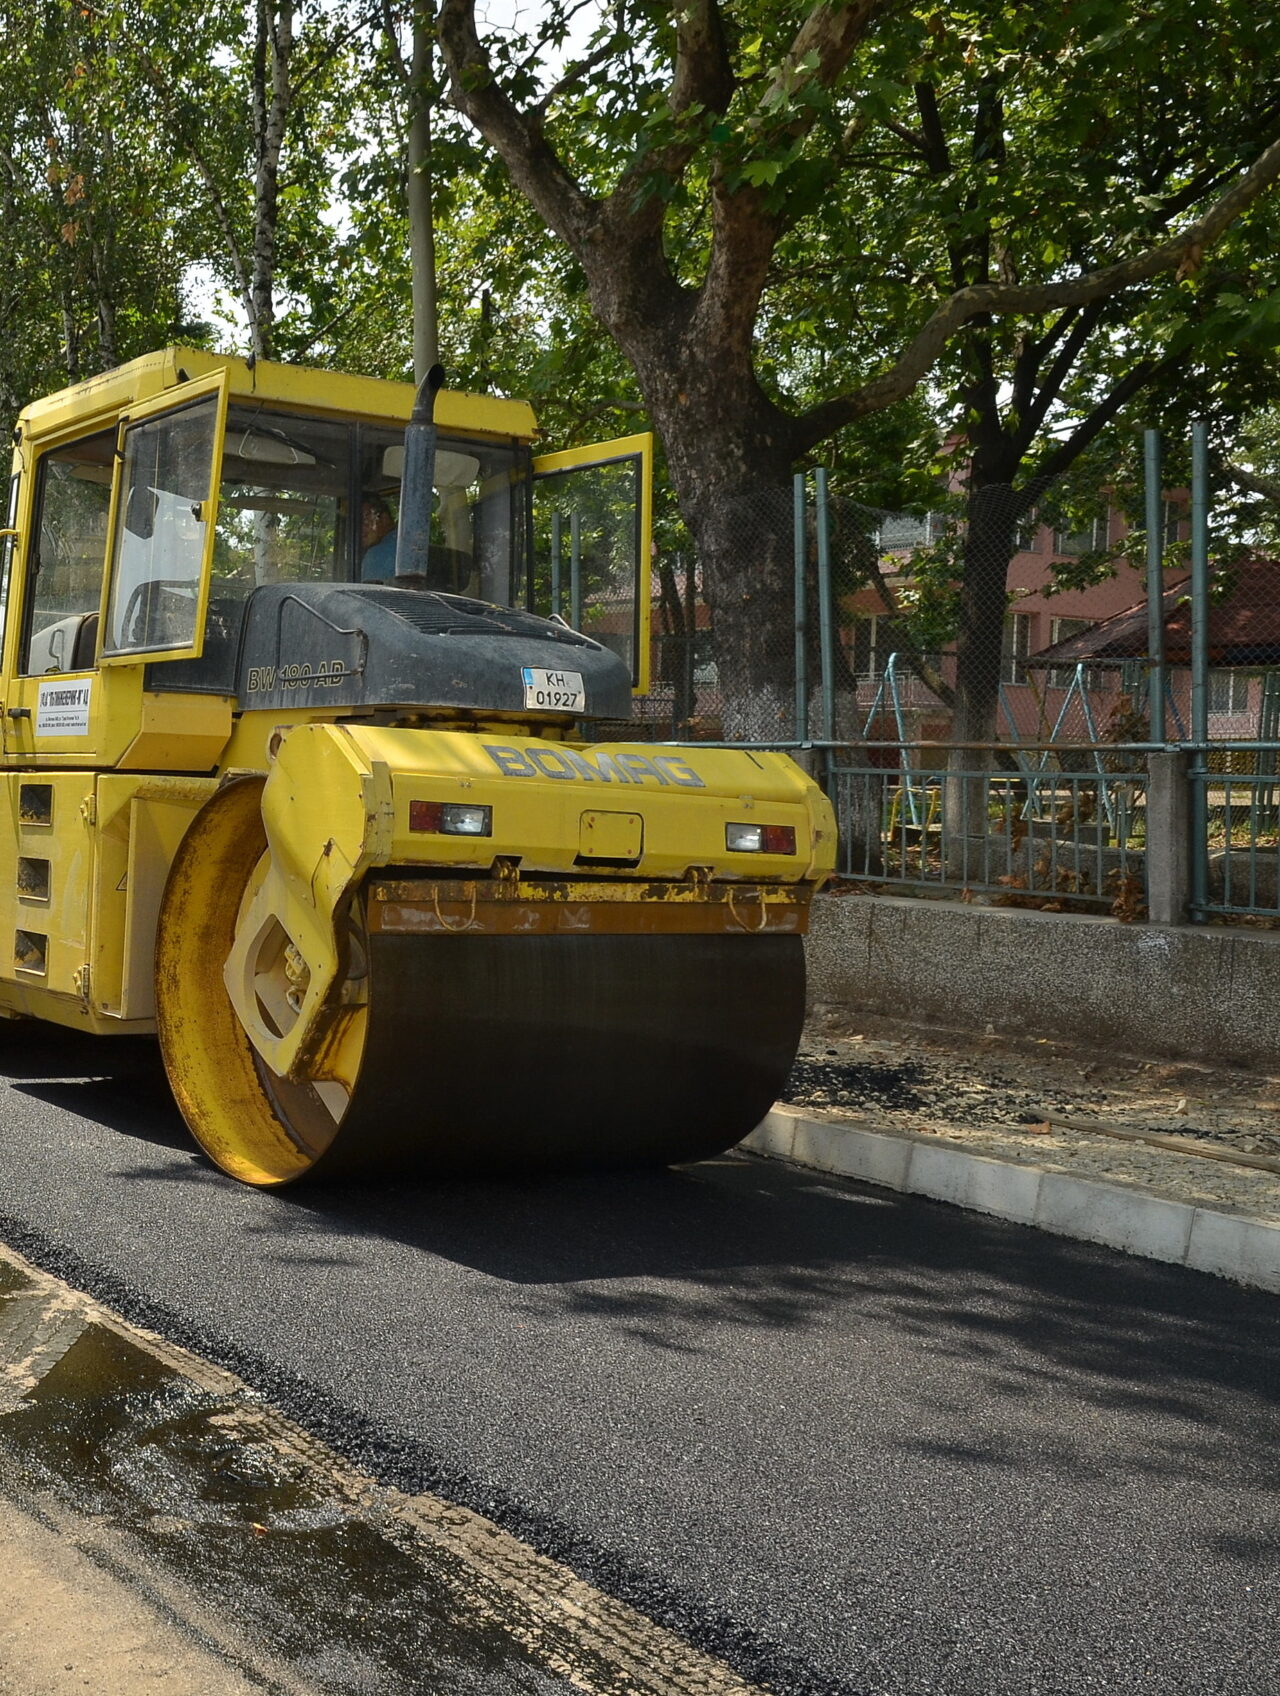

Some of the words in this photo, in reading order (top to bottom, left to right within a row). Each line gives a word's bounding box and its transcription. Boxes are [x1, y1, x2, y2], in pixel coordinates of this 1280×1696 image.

[247, 666, 276, 692] BW
[314, 660, 345, 687] AD
[545, 673, 566, 687] KH
[536, 691, 577, 707] 01927
[481, 745, 707, 788] BOMAG
